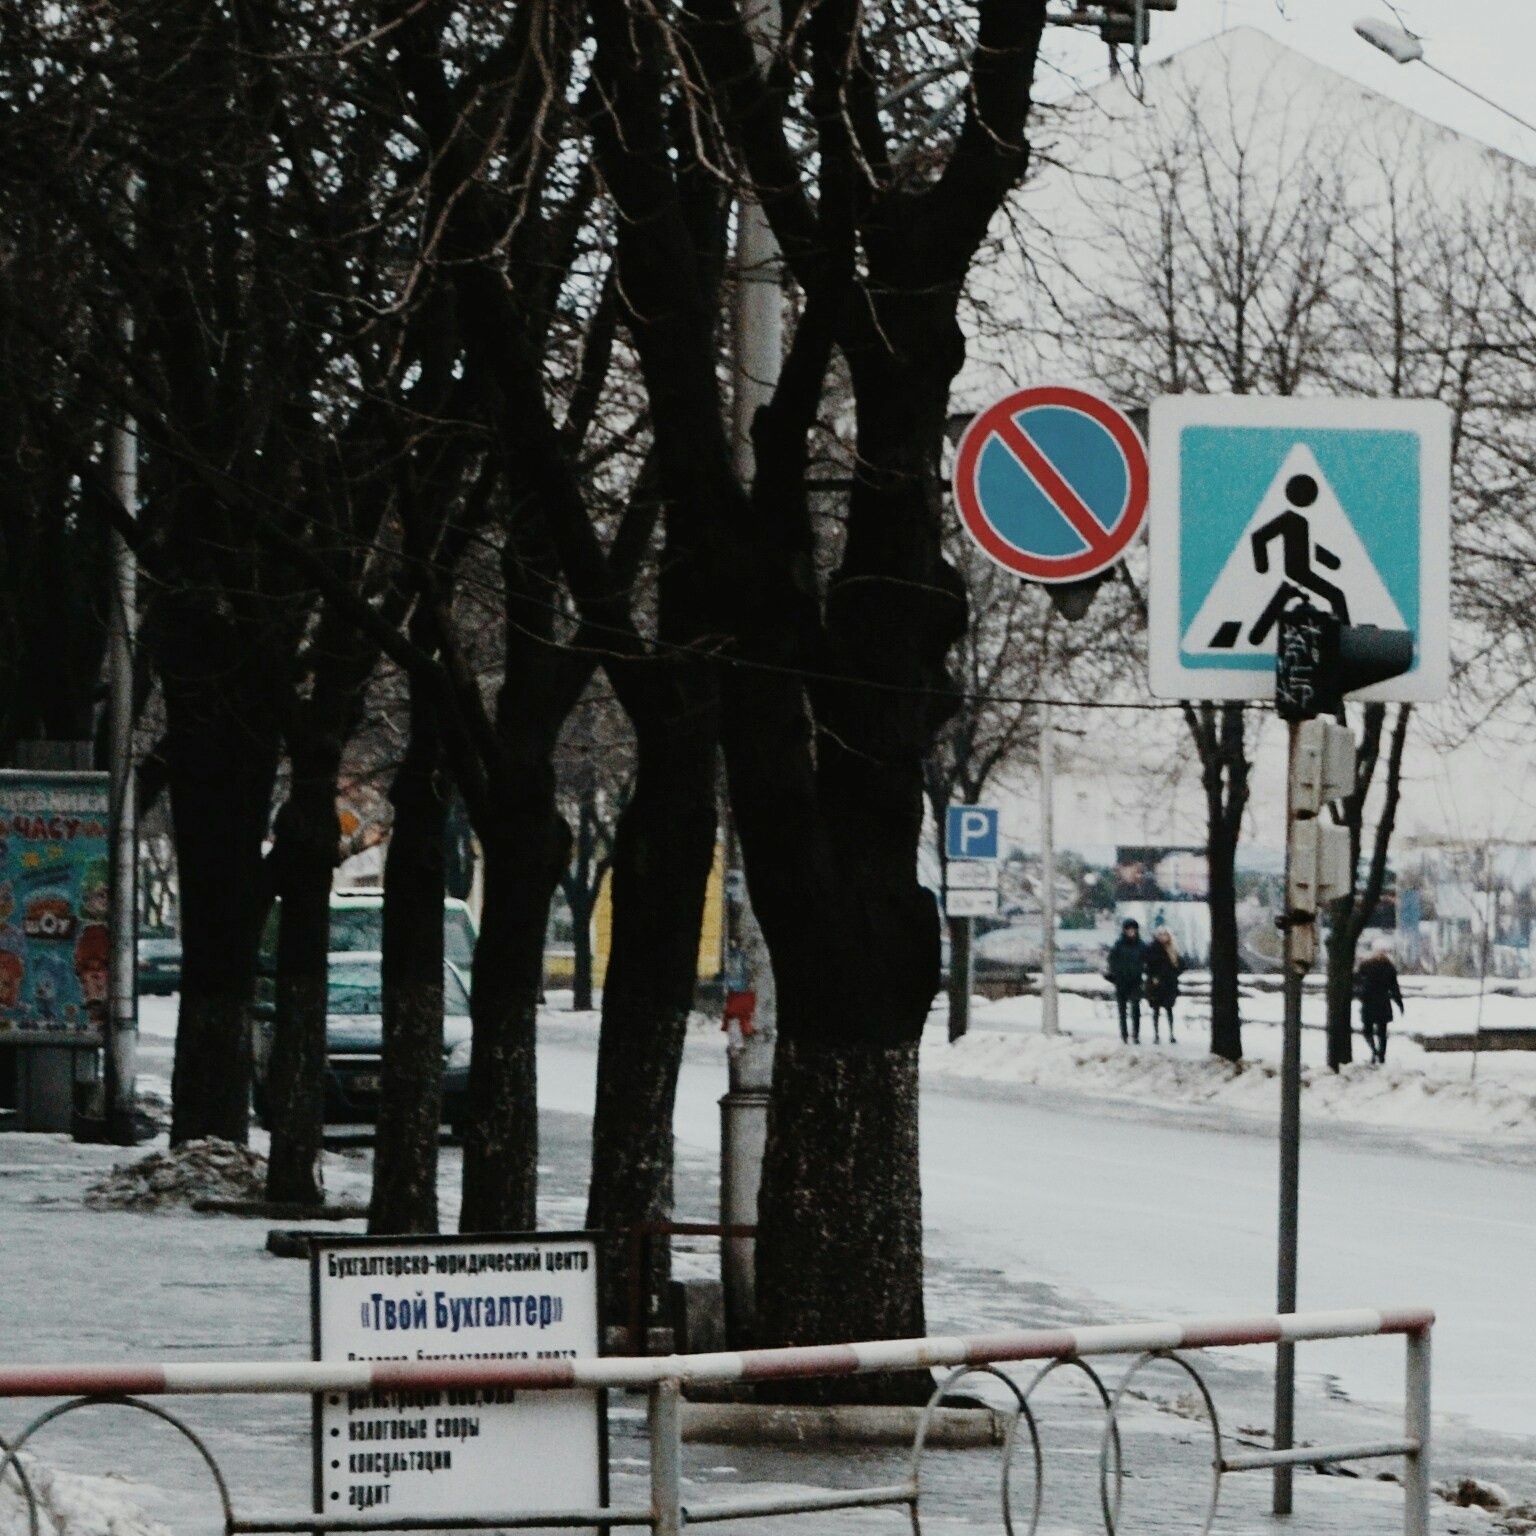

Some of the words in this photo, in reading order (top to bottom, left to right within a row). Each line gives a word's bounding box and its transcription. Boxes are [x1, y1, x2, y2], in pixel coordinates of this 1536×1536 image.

[960, 811, 990, 854] P
[328, 1247, 541, 1279] Бухгалтерско-юридический
[545, 1250, 588, 1274] центр
[349, 1420, 428, 1441] налоговые
[436, 1417, 480, 1443] споры
[349, 1451, 451, 1478] консультации
[349, 1485, 391, 1511] аудит
